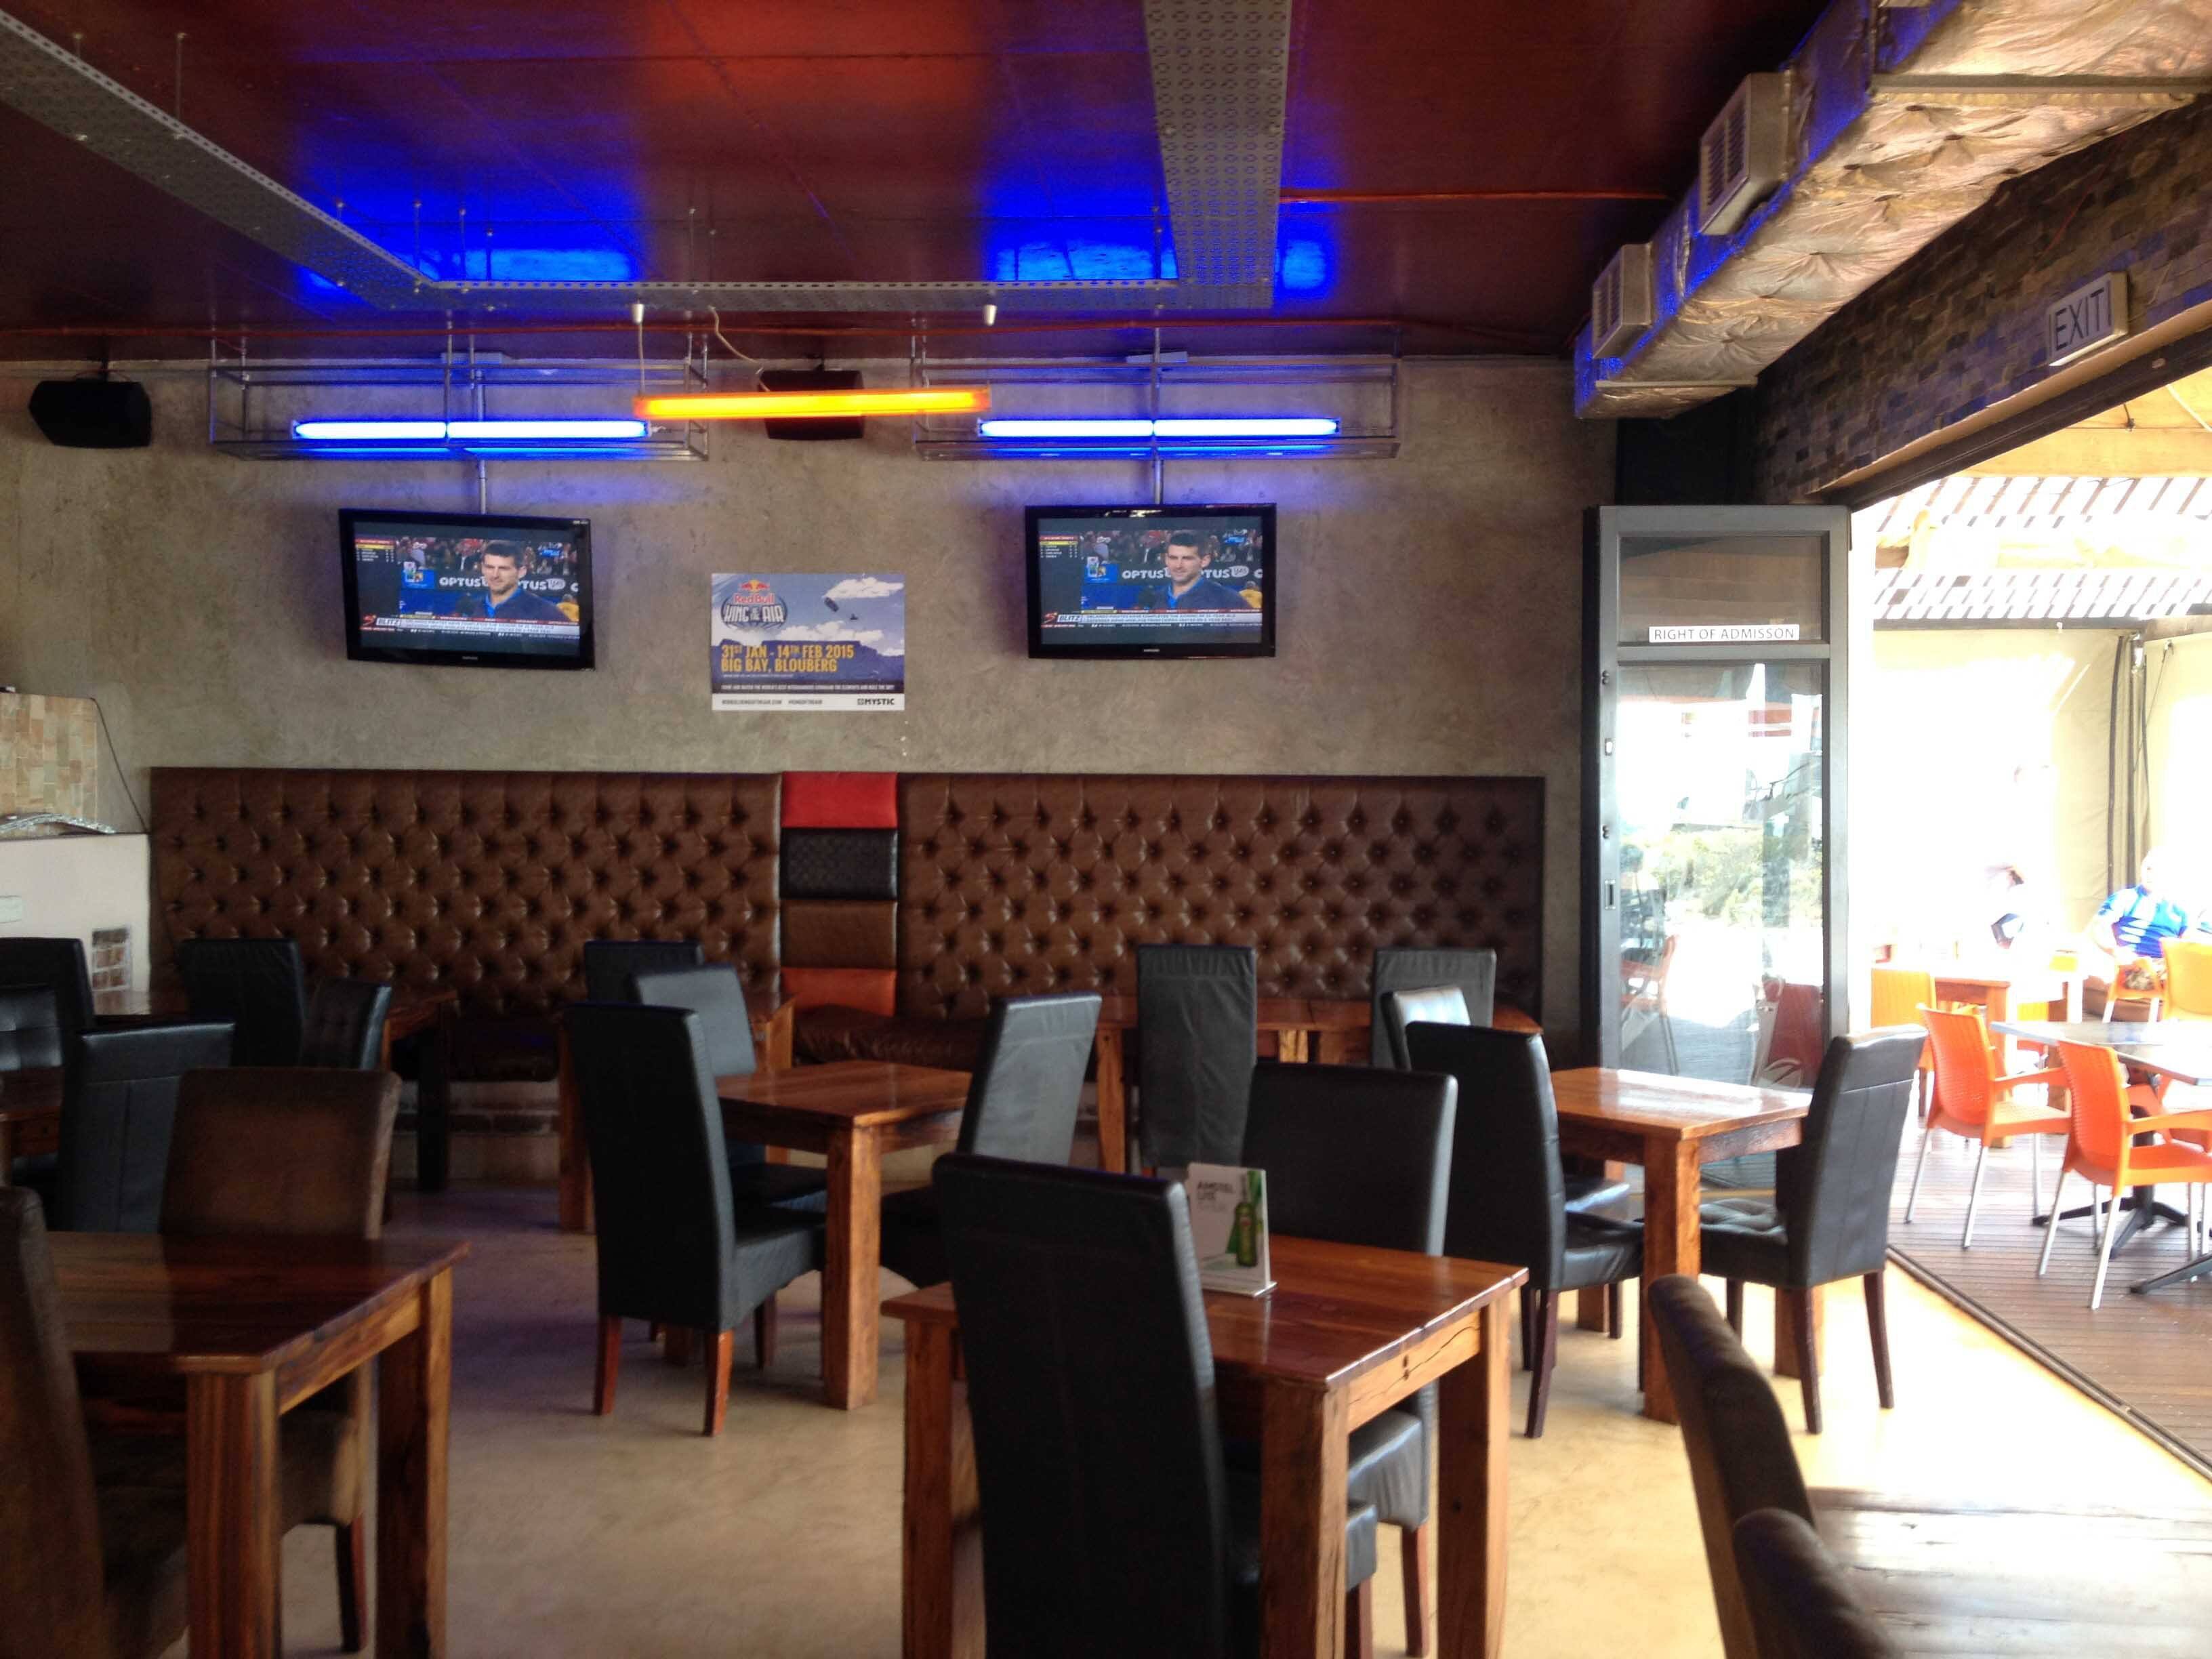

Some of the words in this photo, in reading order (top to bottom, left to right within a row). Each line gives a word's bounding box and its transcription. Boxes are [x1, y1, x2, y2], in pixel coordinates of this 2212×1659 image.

[2055, 287, 2104, 351] EXIT
[1122, 570, 1163, 579] OPTUS
[1201, 569, 1230, 579] TUS
[439, 577, 481, 587] OPTUS
[518, 580, 547, 590] TUS
[734, 594, 754, 603] Red
[754, 593, 775, 603] Bull
[724, 605, 750, 622] KING
[762, 605, 785, 622] AIR
[1654, 629, 1695, 640] RIGHT
[1699, 629, 1716, 640] OF
[1721, 628, 1795, 639] ADMISSON
[746, 644, 767, 658] JAN
[802, 644, 823, 659] FEB
[825, 644, 855, 659] 2015
[721, 658, 742, 672] BIG
[745, 658, 772, 674] BAY,
[775, 658, 838, 672] BLOUBERG
